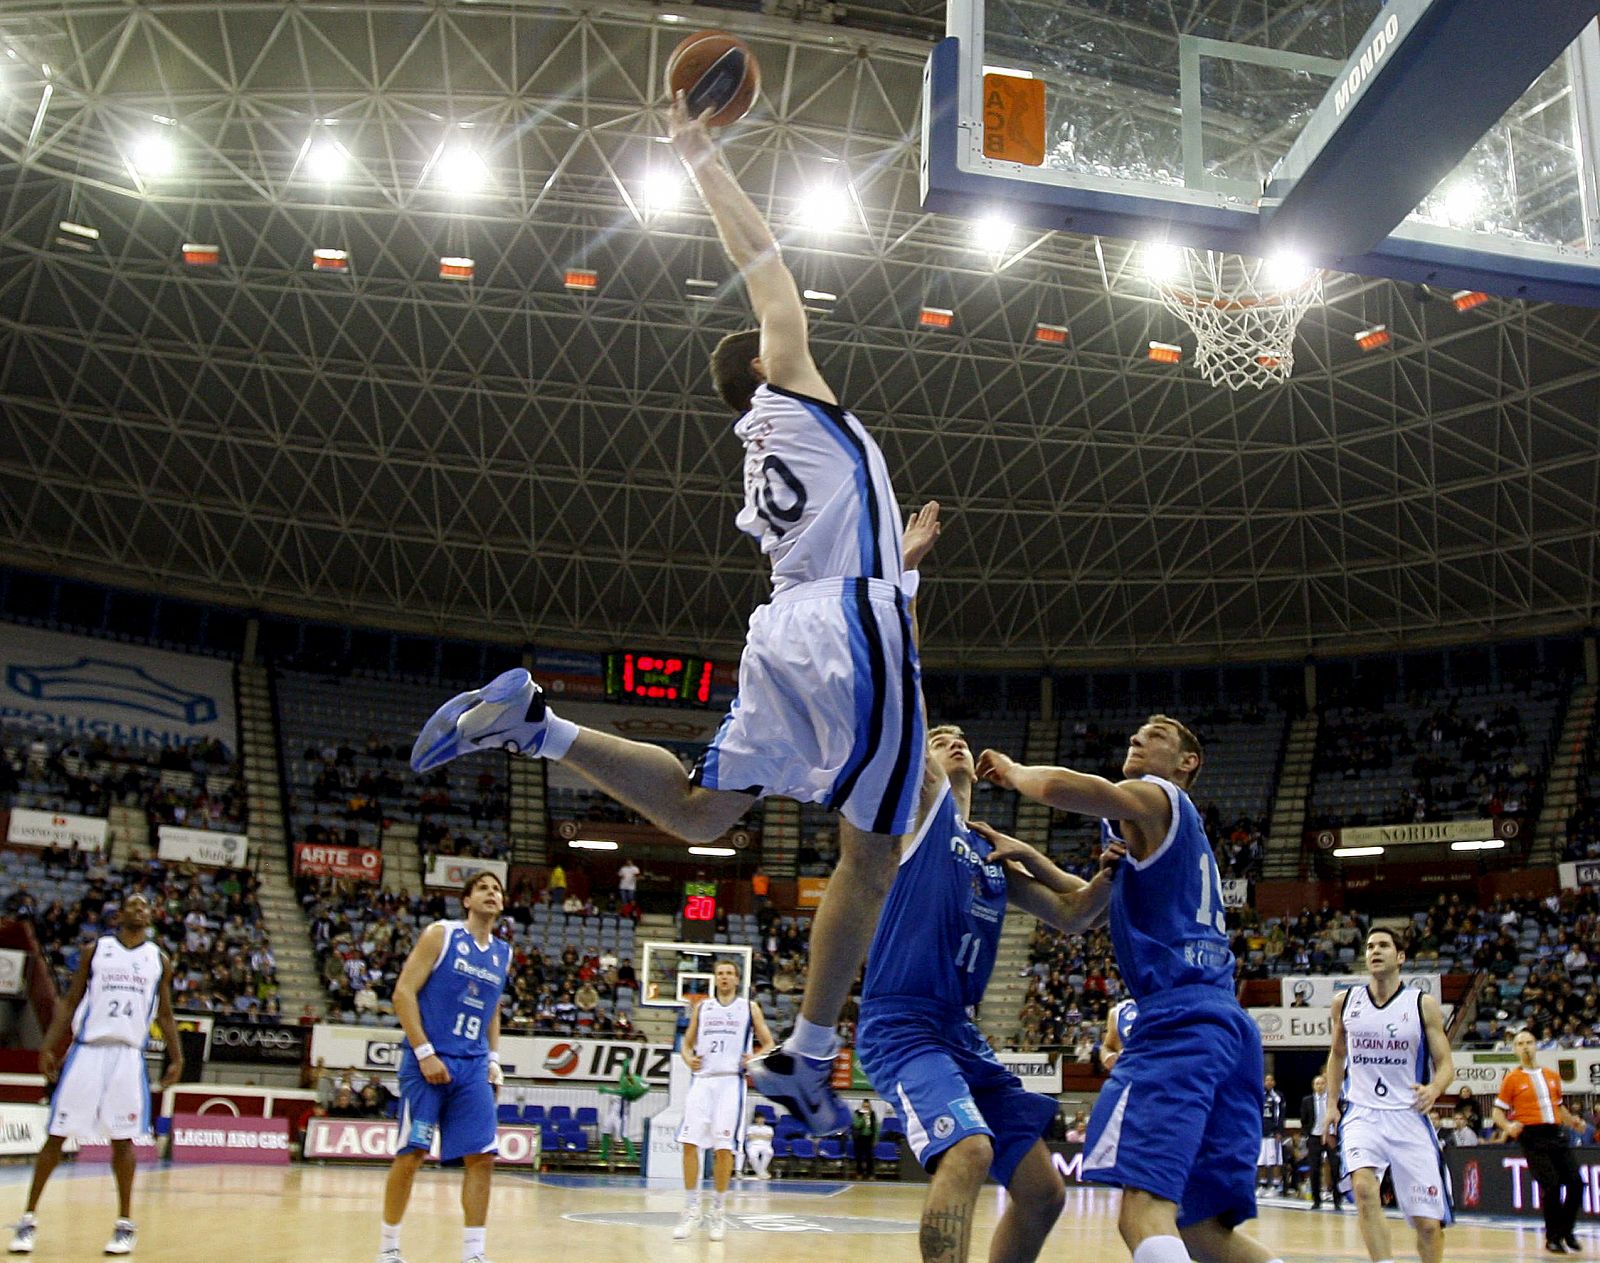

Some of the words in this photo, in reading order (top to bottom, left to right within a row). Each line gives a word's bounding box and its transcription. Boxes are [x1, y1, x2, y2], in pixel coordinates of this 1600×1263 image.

[1334, 14, 1399, 116] MONDO
[1380, 825, 1455, 842] NORDIC
[301, 847, 349, 866] ARTE
[684, 896, 717, 920] 20
[954, 932, 982, 973] 11
[108, 1000, 133, 1018] 24
[452, 1013, 481, 1040] 19
[213, 1026, 294, 1050] BOKADO
[710, 1040, 725, 1053] 21
[1352, 1038, 1384, 1050] LAGUN
[1386, 1040, 1410, 1050] ARO
[1374, 1077, 1389, 1097] 6
